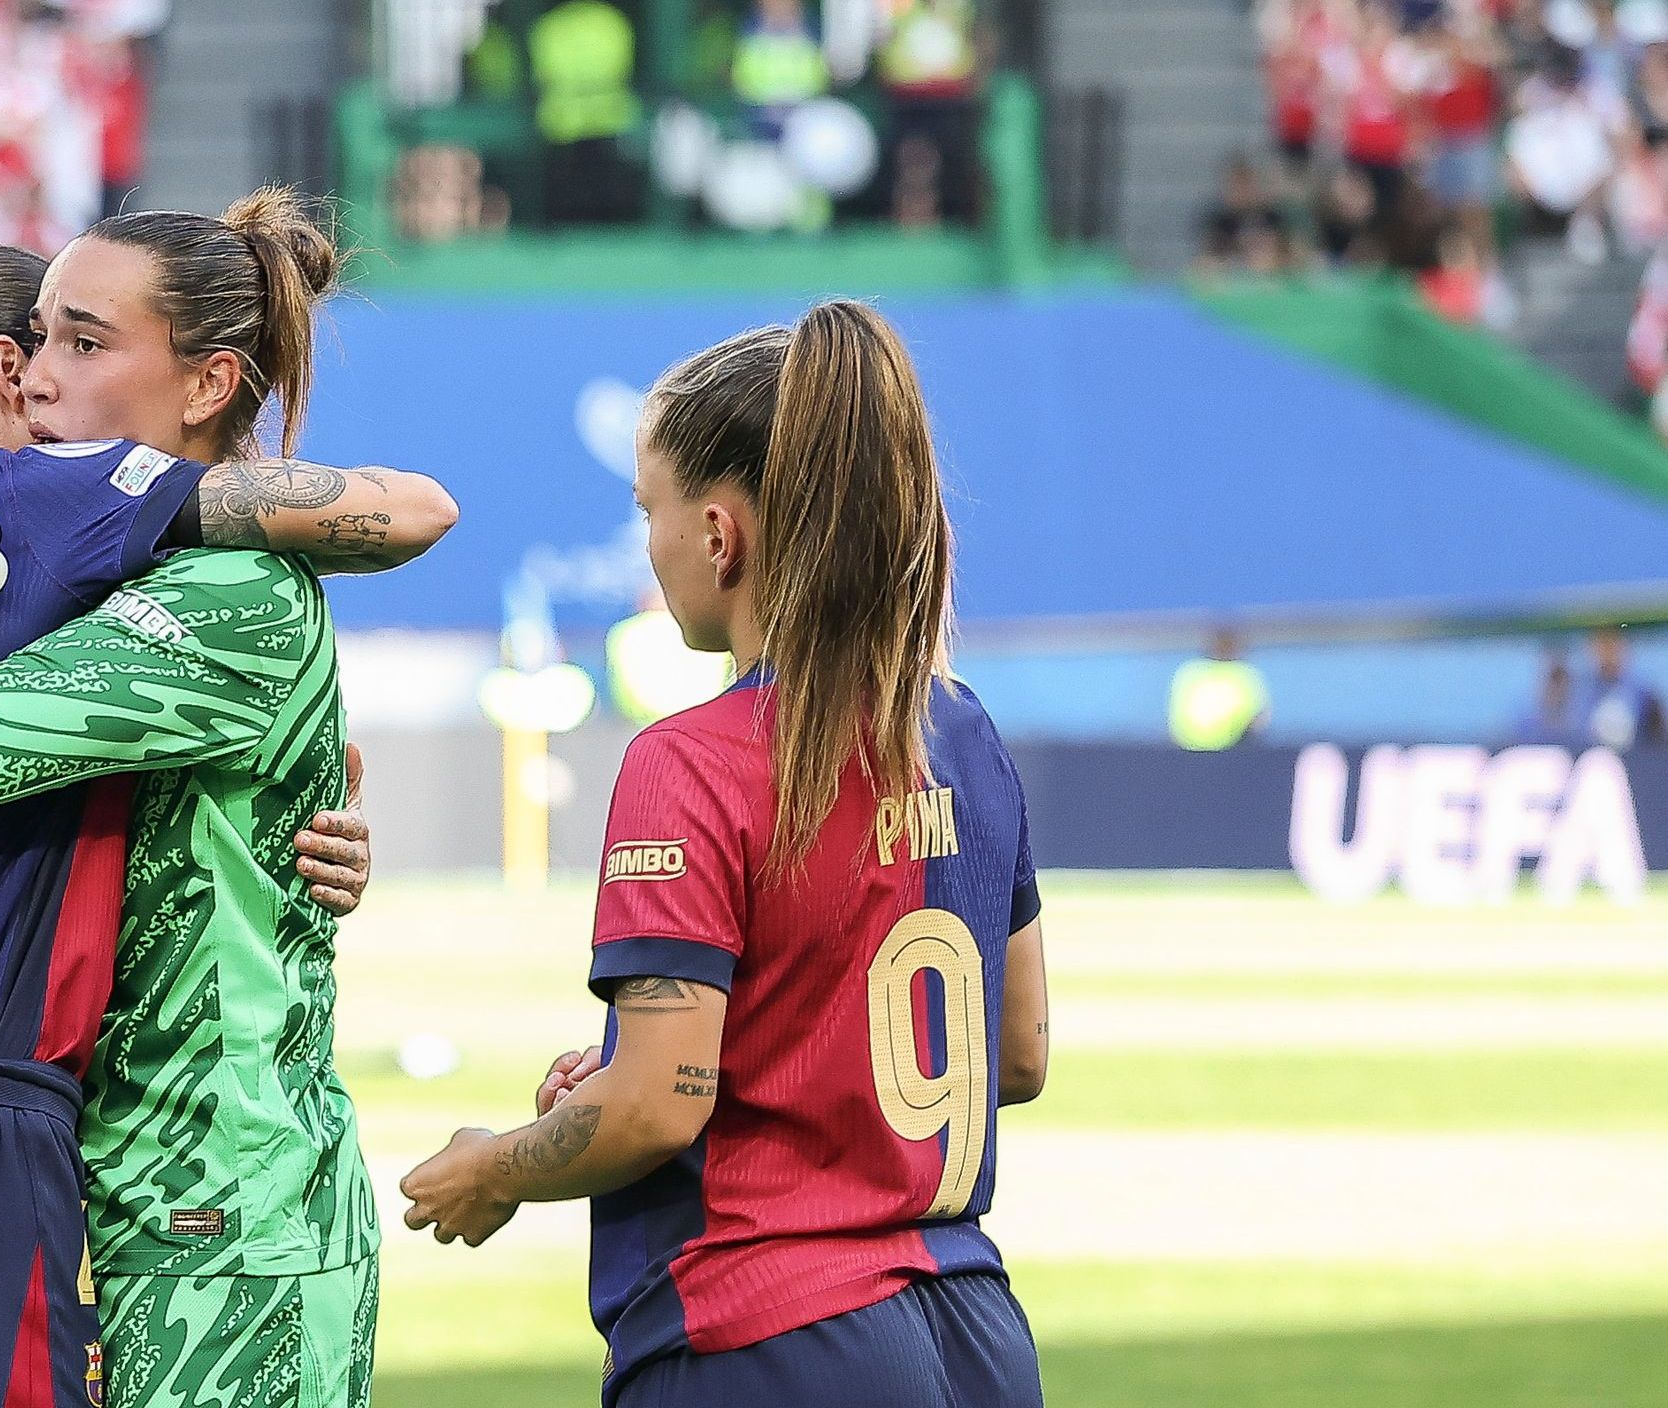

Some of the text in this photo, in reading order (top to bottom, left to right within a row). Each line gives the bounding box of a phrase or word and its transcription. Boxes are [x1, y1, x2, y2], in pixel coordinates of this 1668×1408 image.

[605, 846, 683, 880] BIMBO
[1289, 741, 1647, 905] UEFA
[867, 908, 989, 1219] 9
